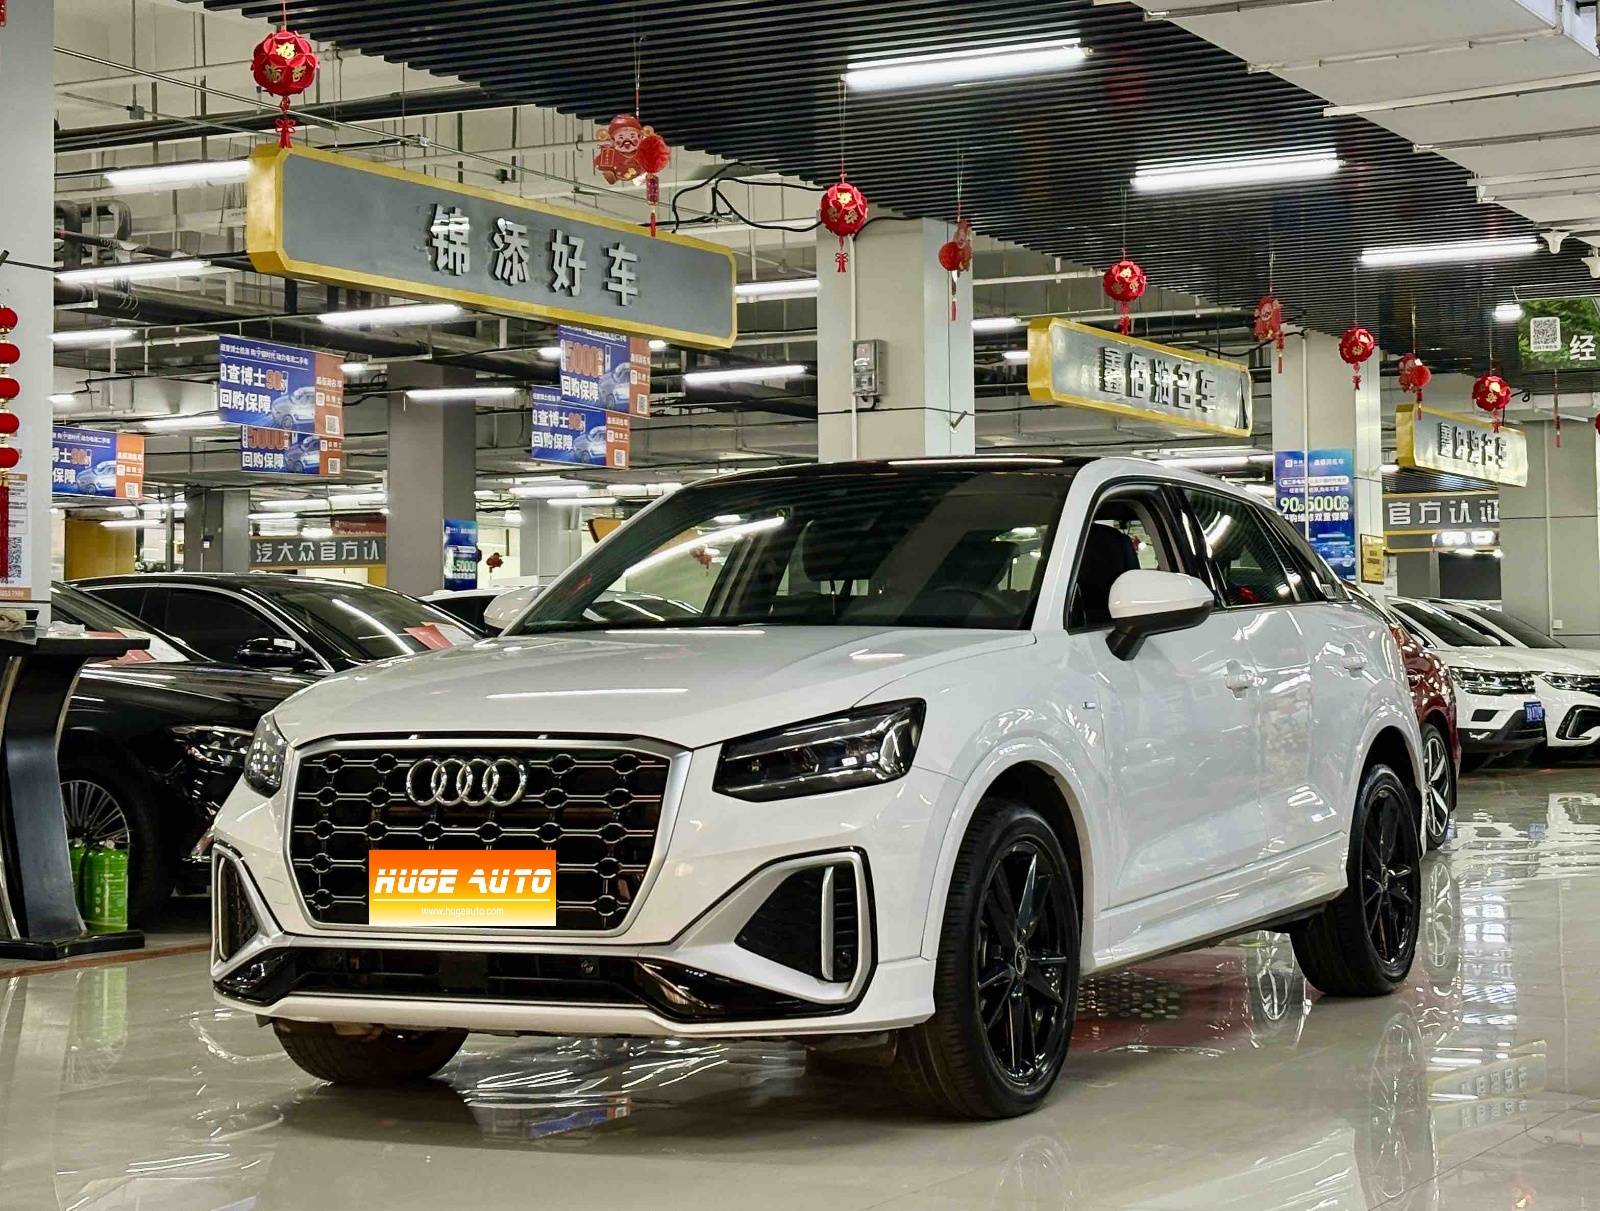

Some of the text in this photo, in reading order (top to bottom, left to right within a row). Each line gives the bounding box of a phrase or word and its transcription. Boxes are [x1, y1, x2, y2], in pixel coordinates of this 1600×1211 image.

[429, 203, 639, 306] 锦添好车
[1569, 334, 1597, 361] 经
[219, 388, 272, 414] 回购保障
[560, 375, 600, 402] 回购保障
[531, 430, 574, 452] 回购保障
[242, 451, 285, 469] 回购保障
[1388, 499, 1500, 525] 官方认证
[250, 540, 380, 562] 汽大众官方认
